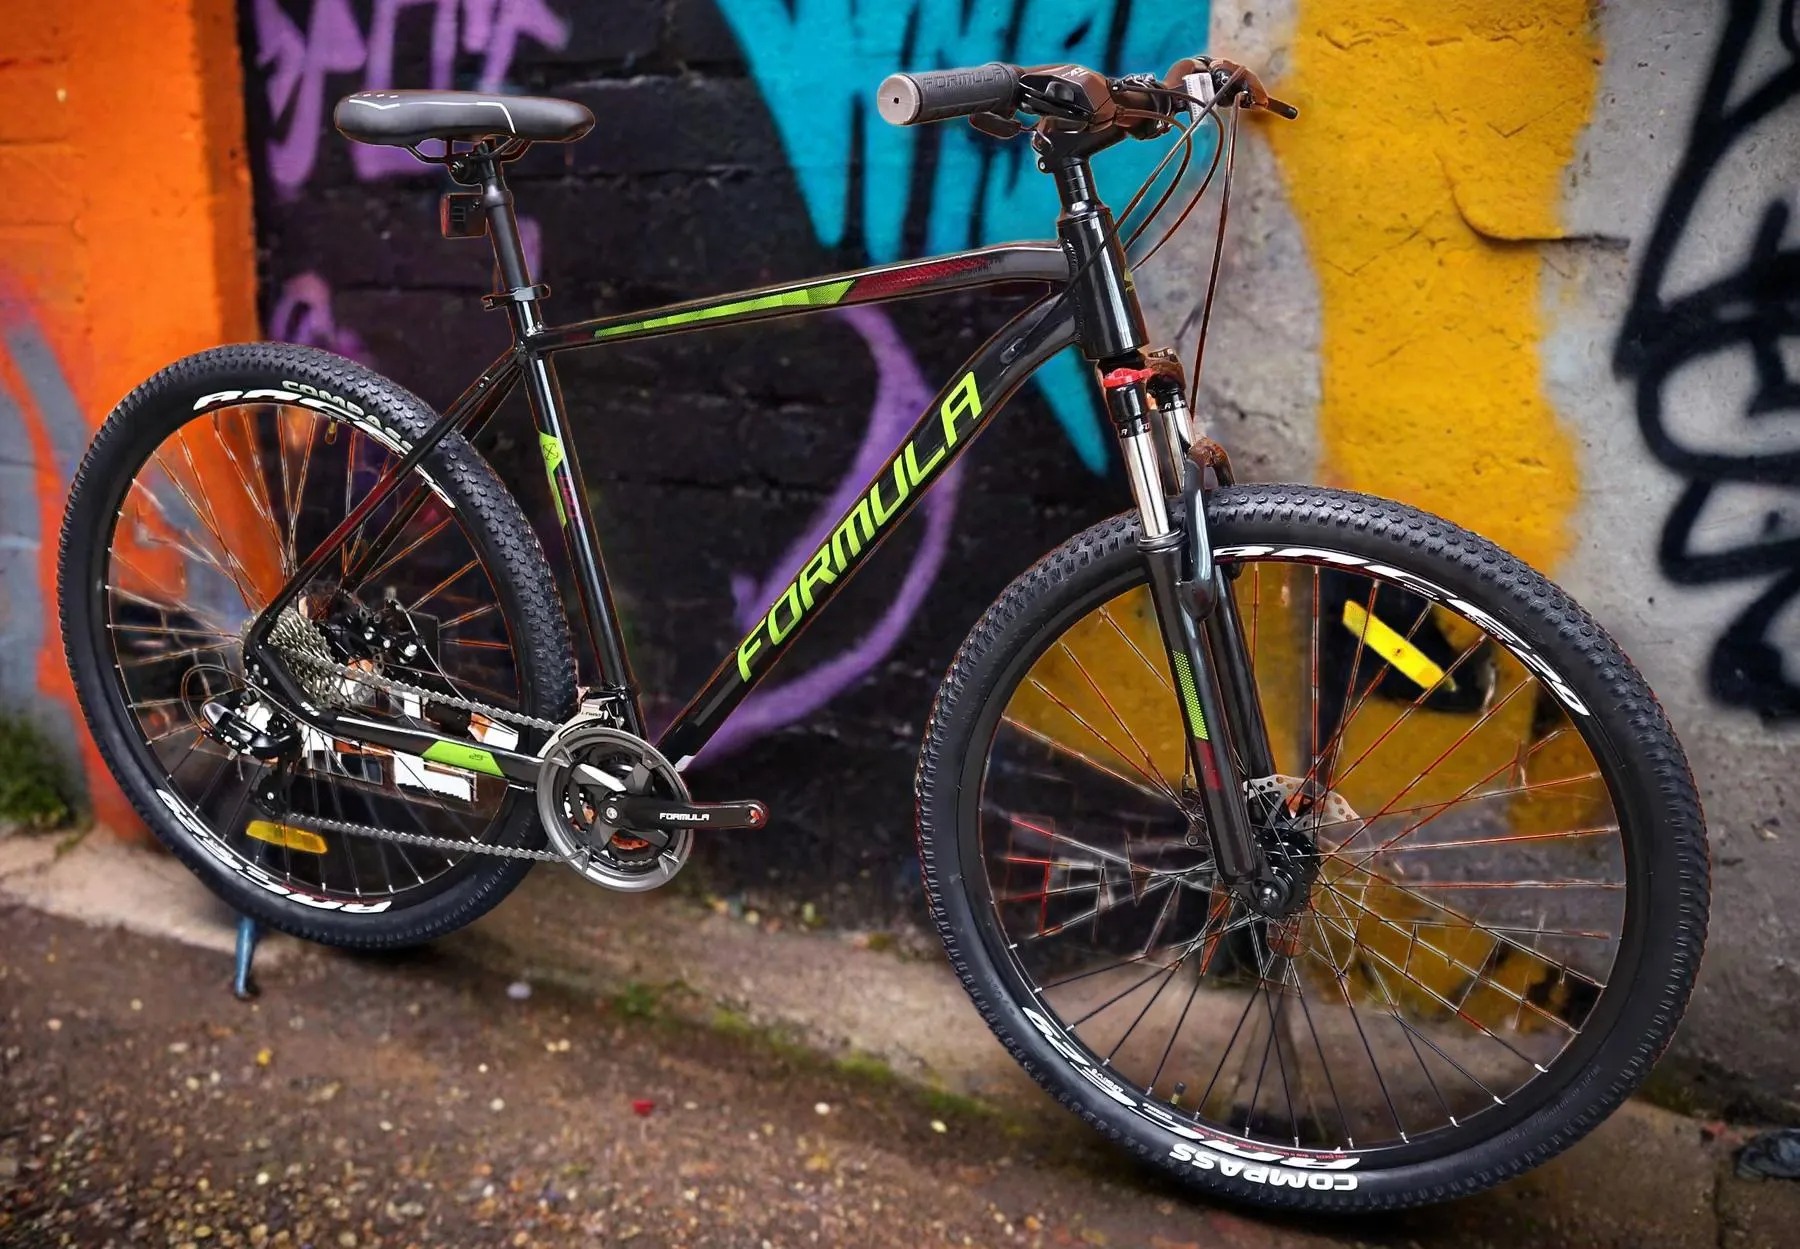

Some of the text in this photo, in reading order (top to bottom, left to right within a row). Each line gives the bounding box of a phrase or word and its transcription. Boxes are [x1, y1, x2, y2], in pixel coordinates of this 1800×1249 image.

[737, 371, 982, 683] FORMULA
[660, 812, 710, 821] FORMULA
[1169, 1143, 1358, 1191] COMPASS
